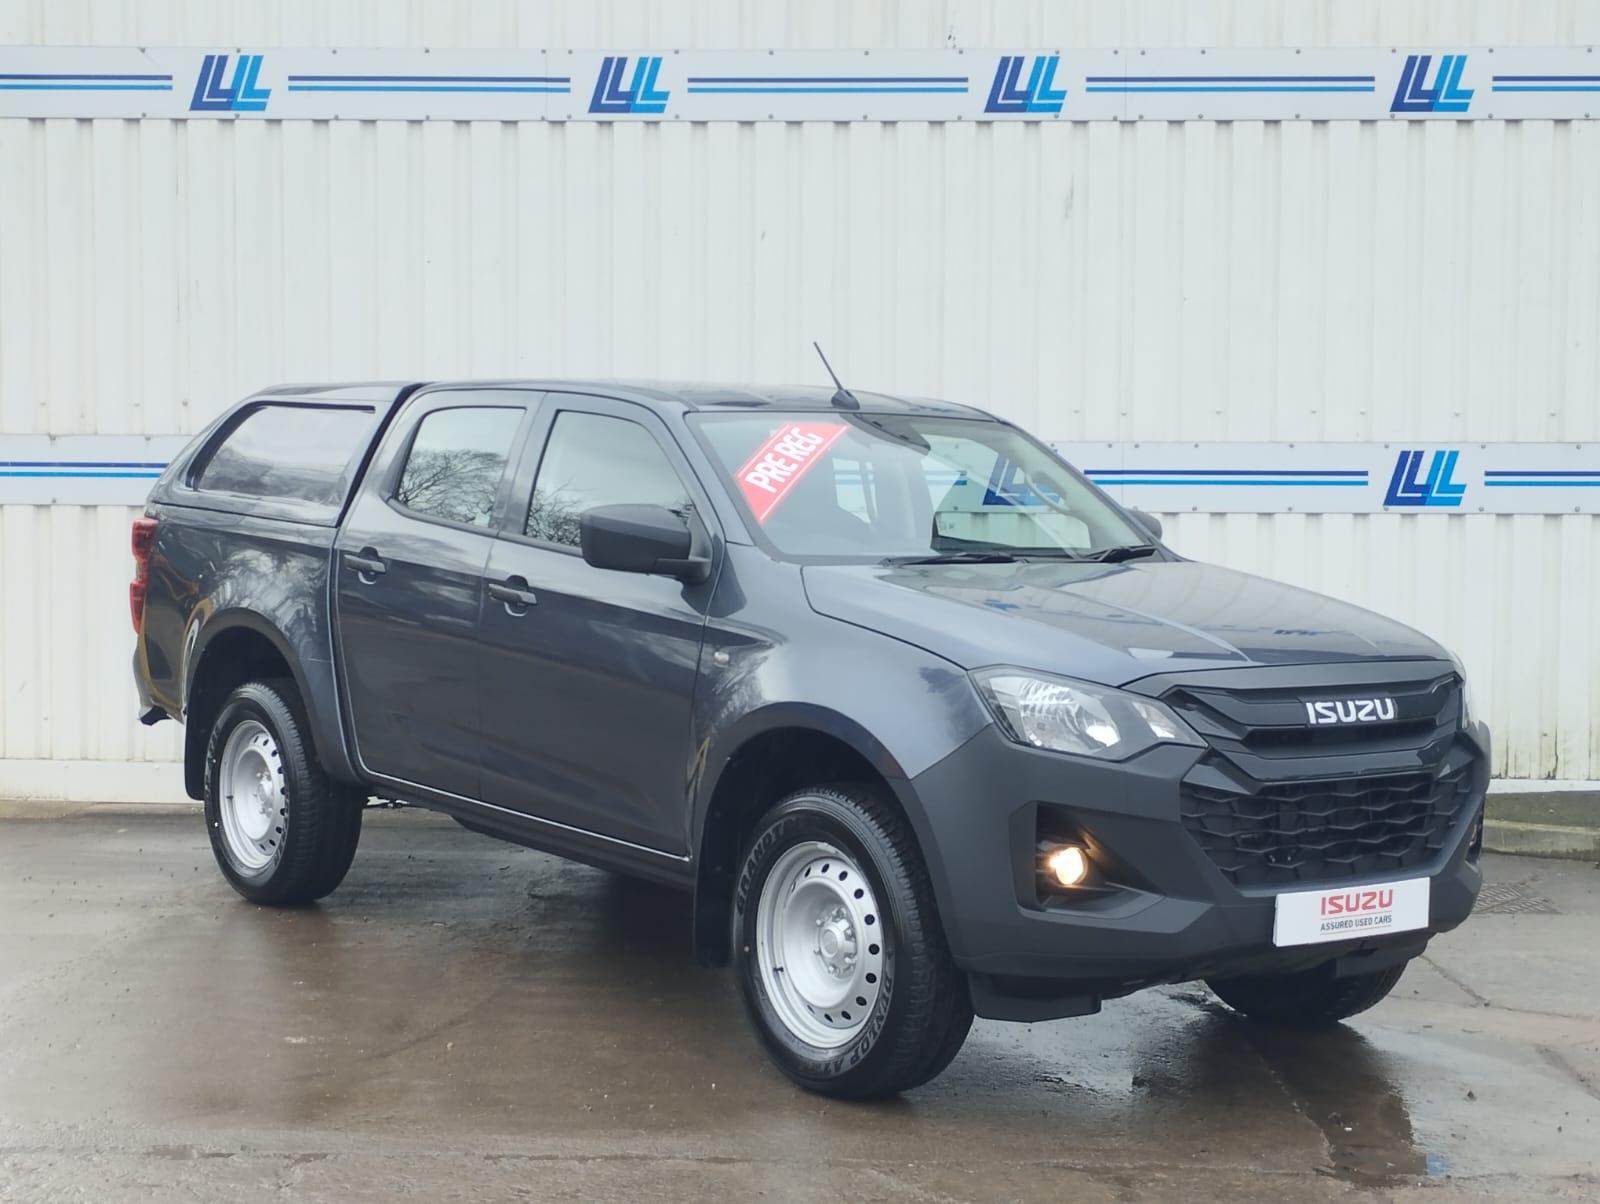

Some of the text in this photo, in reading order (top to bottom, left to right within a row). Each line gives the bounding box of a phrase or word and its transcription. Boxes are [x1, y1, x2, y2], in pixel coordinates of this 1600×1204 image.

[745, 427, 824, 493] PRE REG
[1306, 698, 1394, 724] ISUZU
[1321, 889, 1393, 915] ISUZU
[1320, 915, 1392, 931] ASSURED USED CARS
